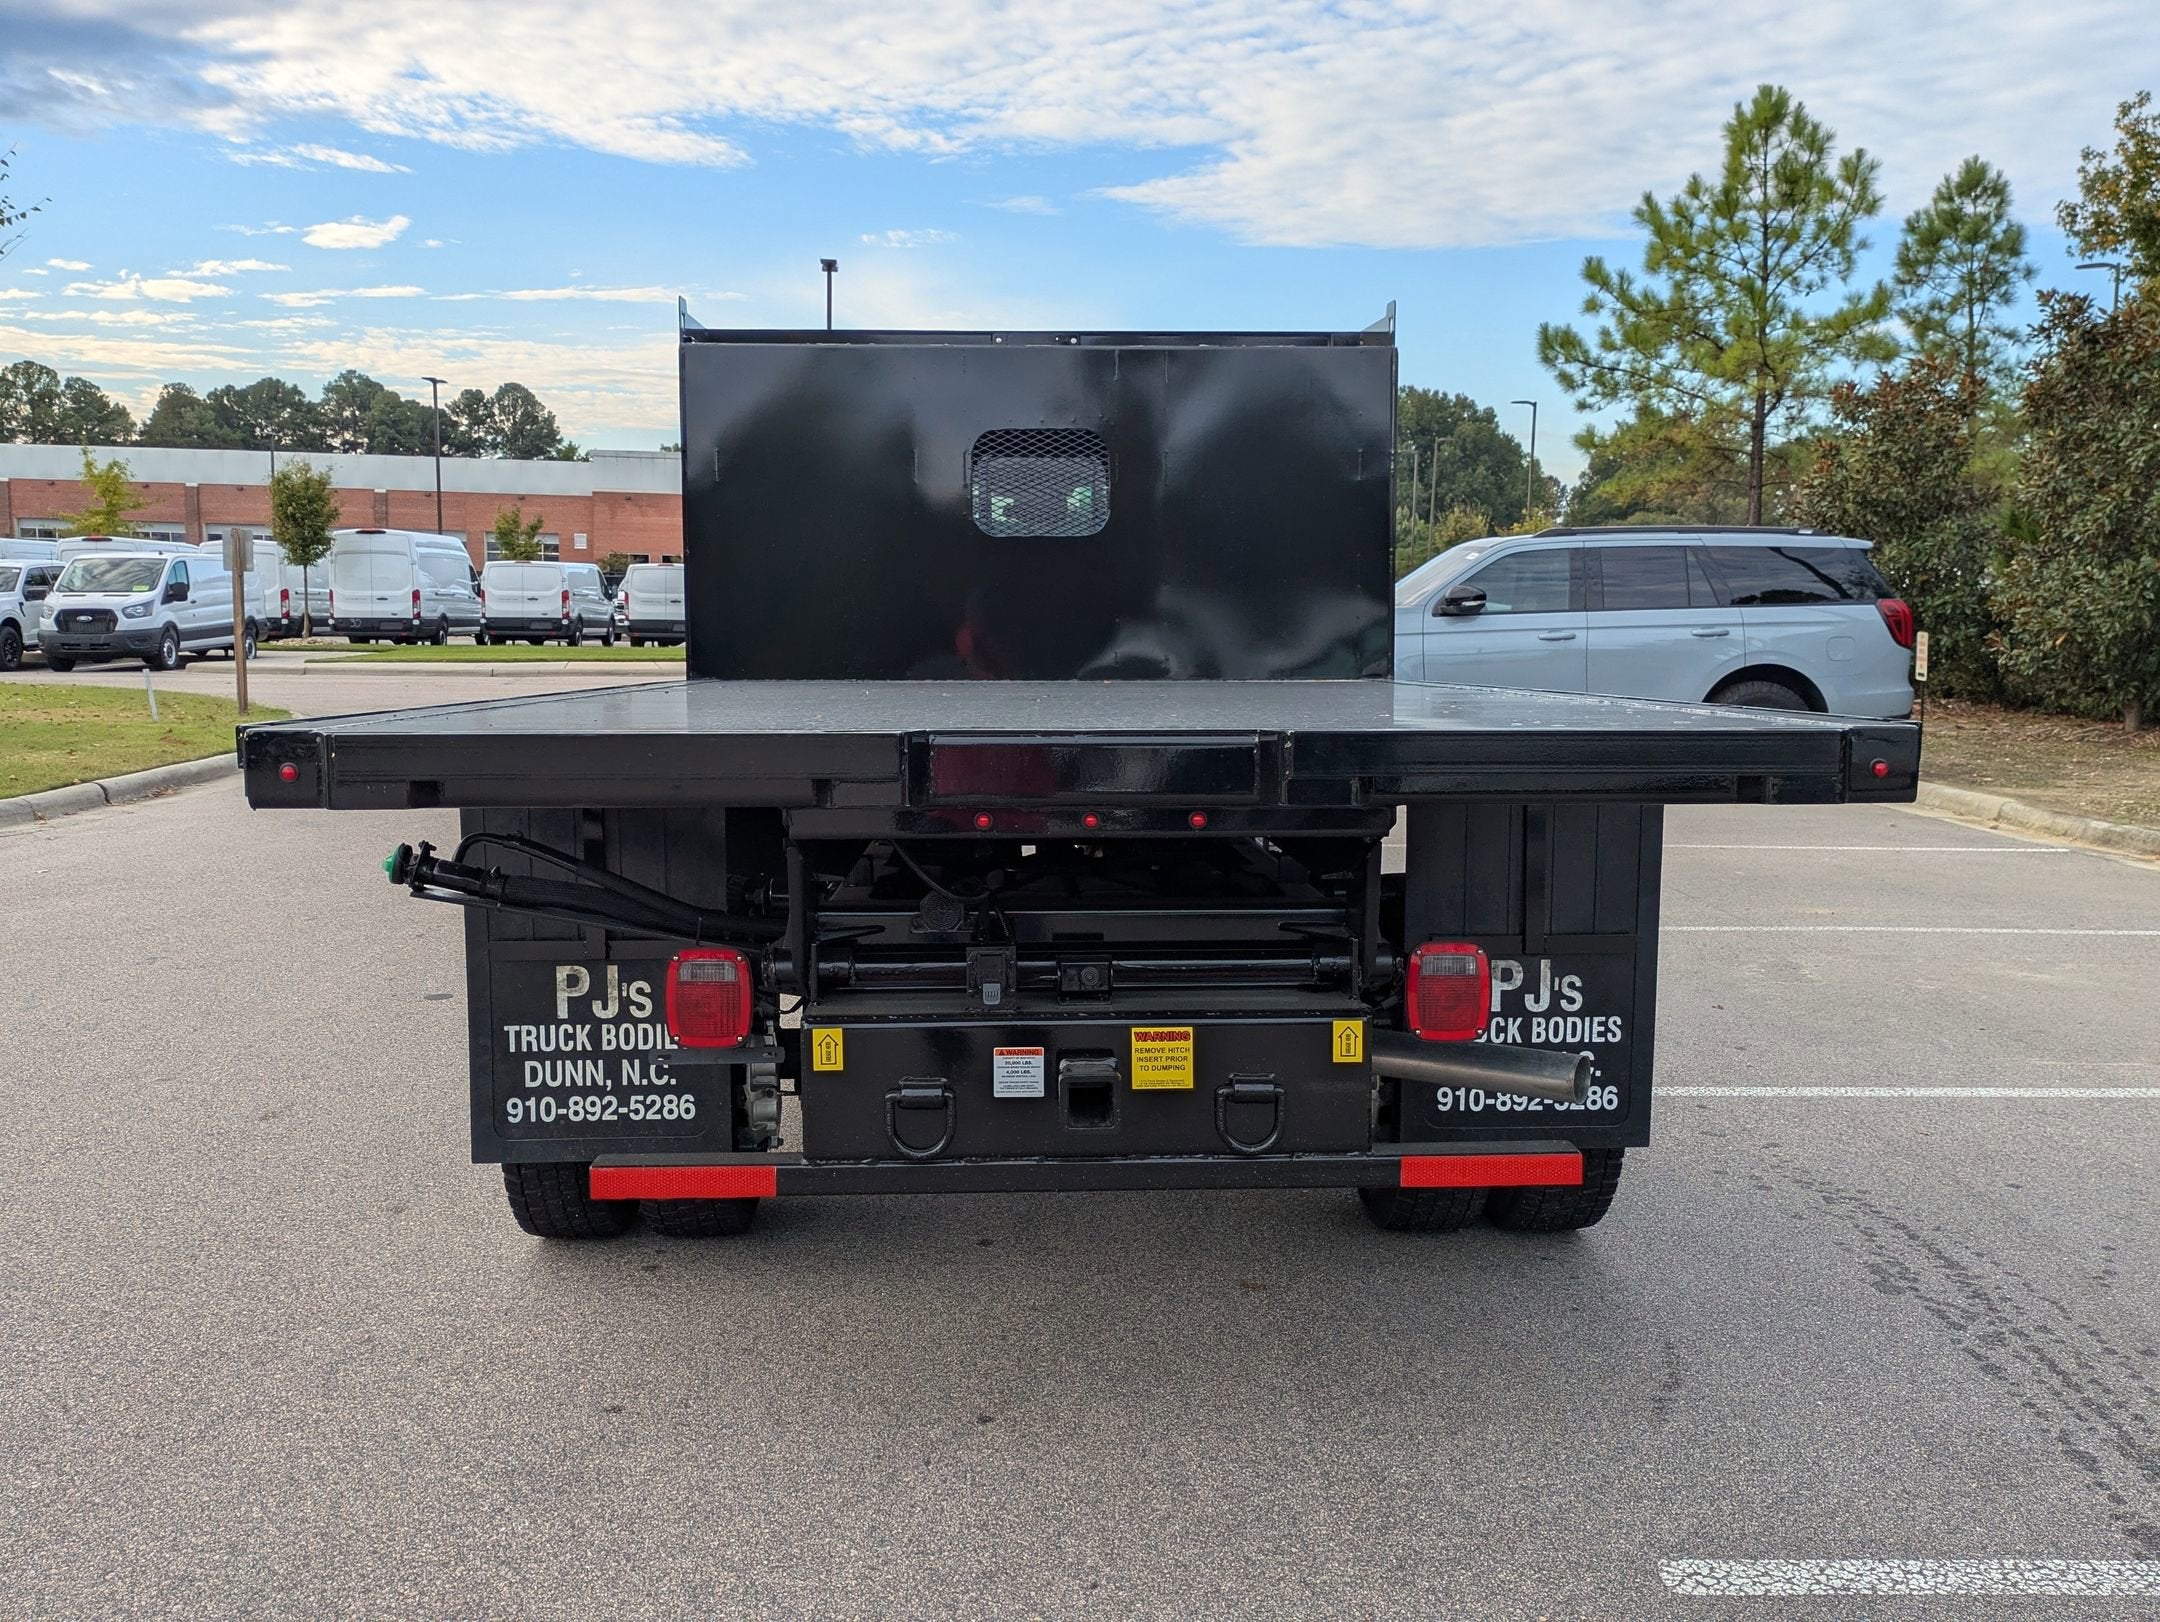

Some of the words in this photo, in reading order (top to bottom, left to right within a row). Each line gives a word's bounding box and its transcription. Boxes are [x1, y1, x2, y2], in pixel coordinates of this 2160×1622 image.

[556, 965, 653, 1020] PJ's
[1491, 959, 1583, 1013] PJ's
[504, 1024, 592, 1052] TRUCK
[1134, 1031, 1191, 1042] WARNING
[1531, 1016, 1622, 1043] BODIES
[1006, 1048, 1040, 1056] WARNING
[525, 1060, 612, 1091] DUNN,
[622, 1059, 677, 1086] N.C.
[506, 1094, 696, 1123] 910-892-5286
[1437, 1086, 1618, 1113] 910-892-86
